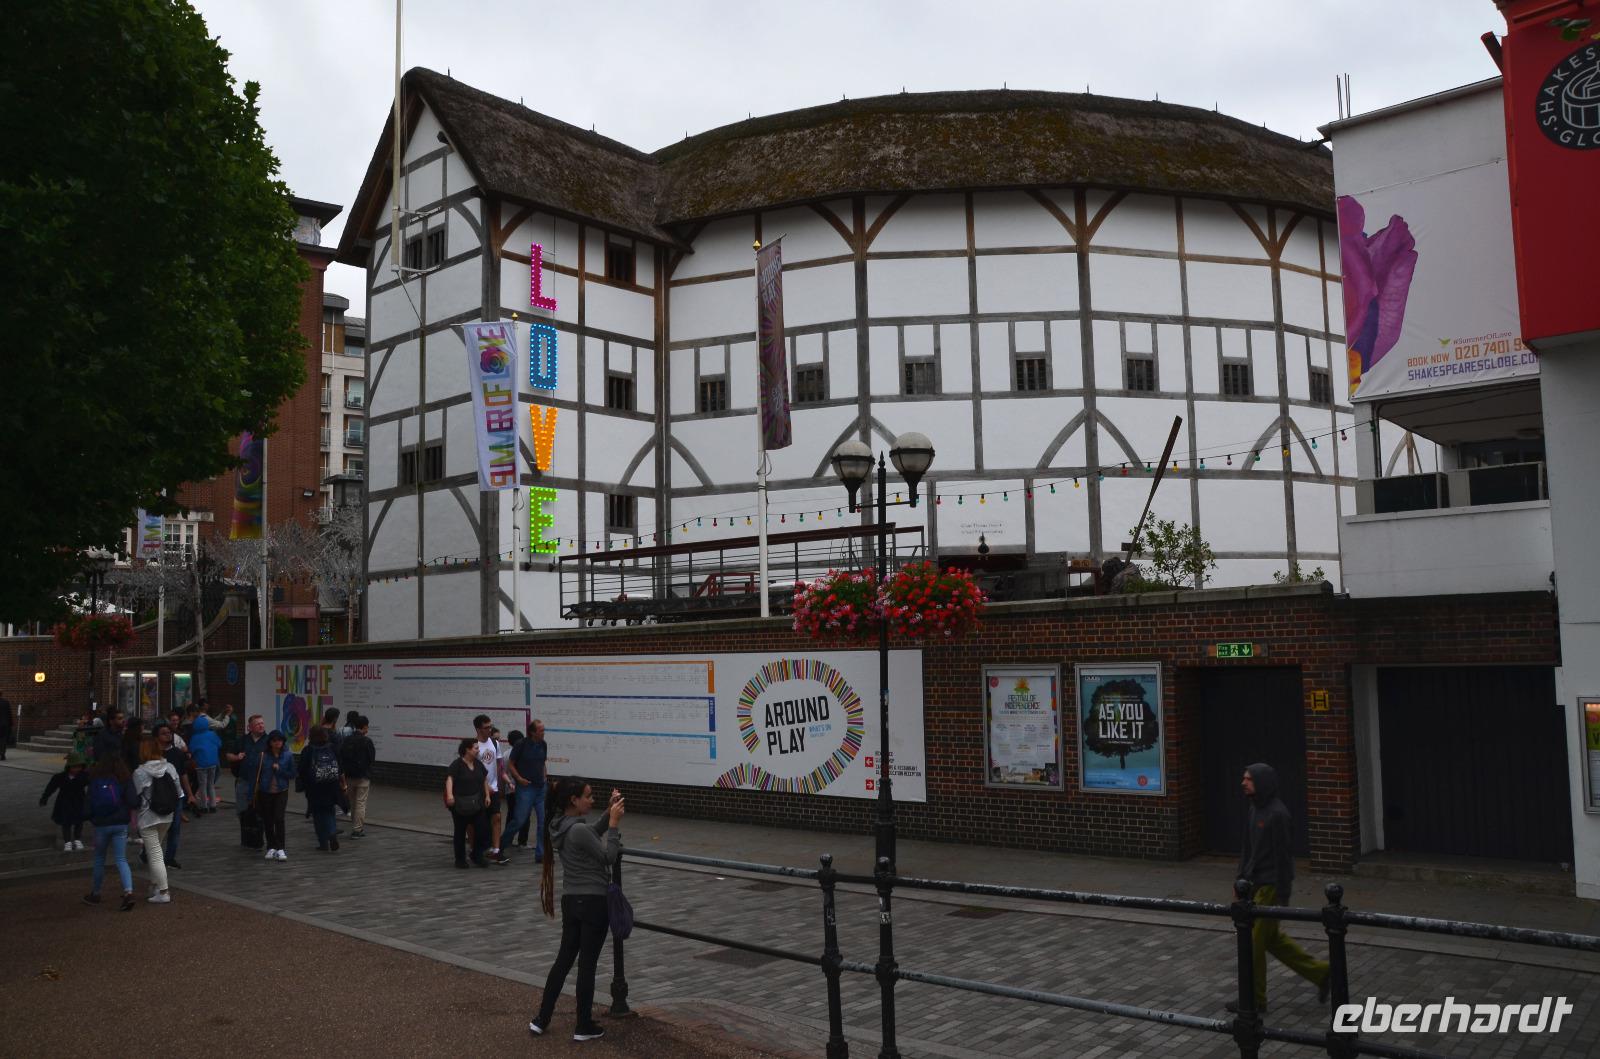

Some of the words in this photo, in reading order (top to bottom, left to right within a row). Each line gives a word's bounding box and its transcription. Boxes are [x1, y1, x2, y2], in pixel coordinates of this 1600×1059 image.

[1407, 356, 1428, 368] BOOK
[1430, 353, 1450, 365] NOW
[1455, 344, 1479, 360] 020
[1484, 340, 1509, 356] 7401
[483, 383, 512, 407] OF
[530, 242, 558, 554] LOVE
[275, 665, 318, 695] SUMMER
[319, 665, 334, 695] OF
[344, 664, 382, 680] SCHEDULE
[765, 696, 830, 728] AROUND
[1099, 703, 1115, 720] AS
[1118, 703, 1144, 720] YOU
[767, 727, 805, 756] PLAY
[1099, 721, 1128, 739] LIKE
[1132, 721, 1145, 739] IT
